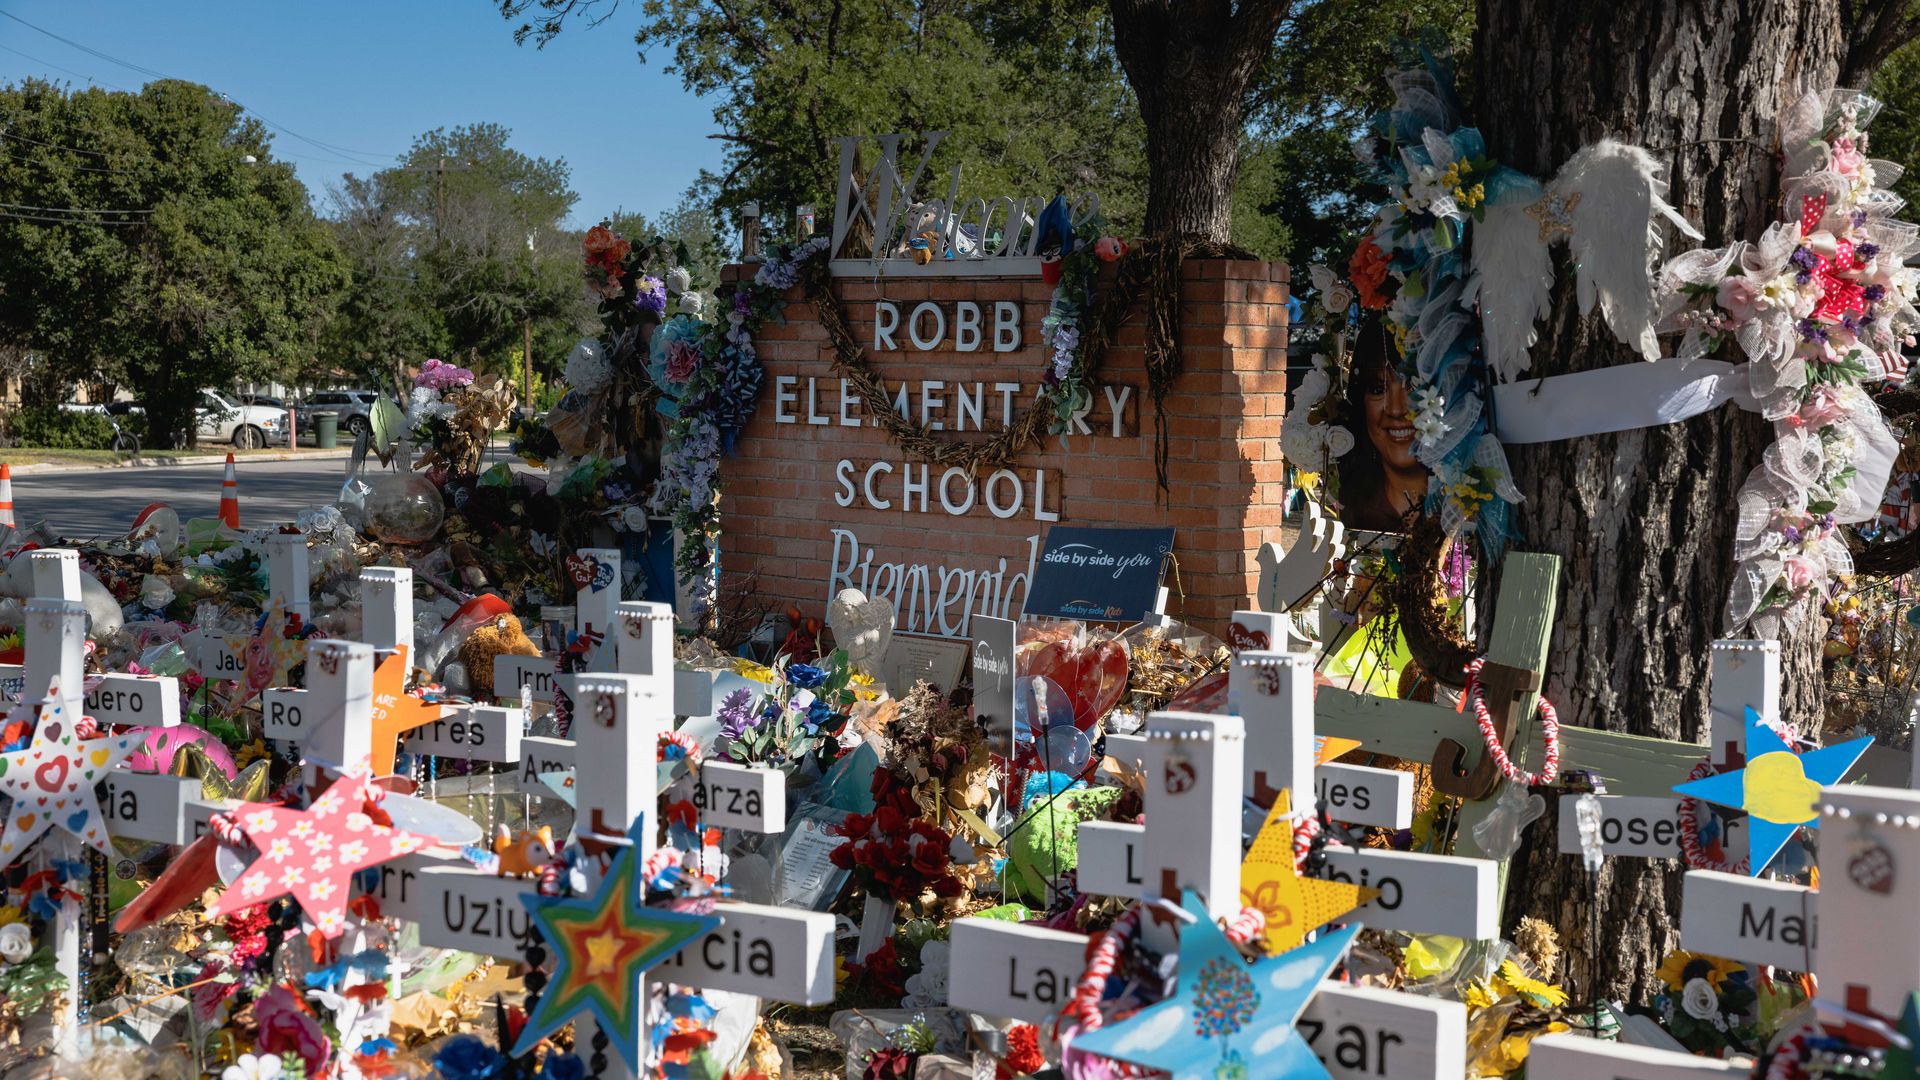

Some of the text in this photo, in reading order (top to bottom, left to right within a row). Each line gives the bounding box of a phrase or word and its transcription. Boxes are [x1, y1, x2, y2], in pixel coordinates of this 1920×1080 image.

[874, 301, 1023, 352] ROBB
[775, 375, 1132, 438] ELEMENTRY
[834, 459, 1061, 522] SCHOOL
[1044, 550, 1152, 579] side by side you
[1060, 604, 1077, 613] side
[1077, 605, 1089, 615] by
[1088, 604, 1105, 616] side
[973, 649, 983, 670] side
[983, 654, 989, 675] by
[85, 690, 143, 712] uero
[375, 693, 398, 708] ARE
[523, 754, 576, 783] Am
[101, 783, 137, 821] ia
[1314, 778, 1370, 810] les
